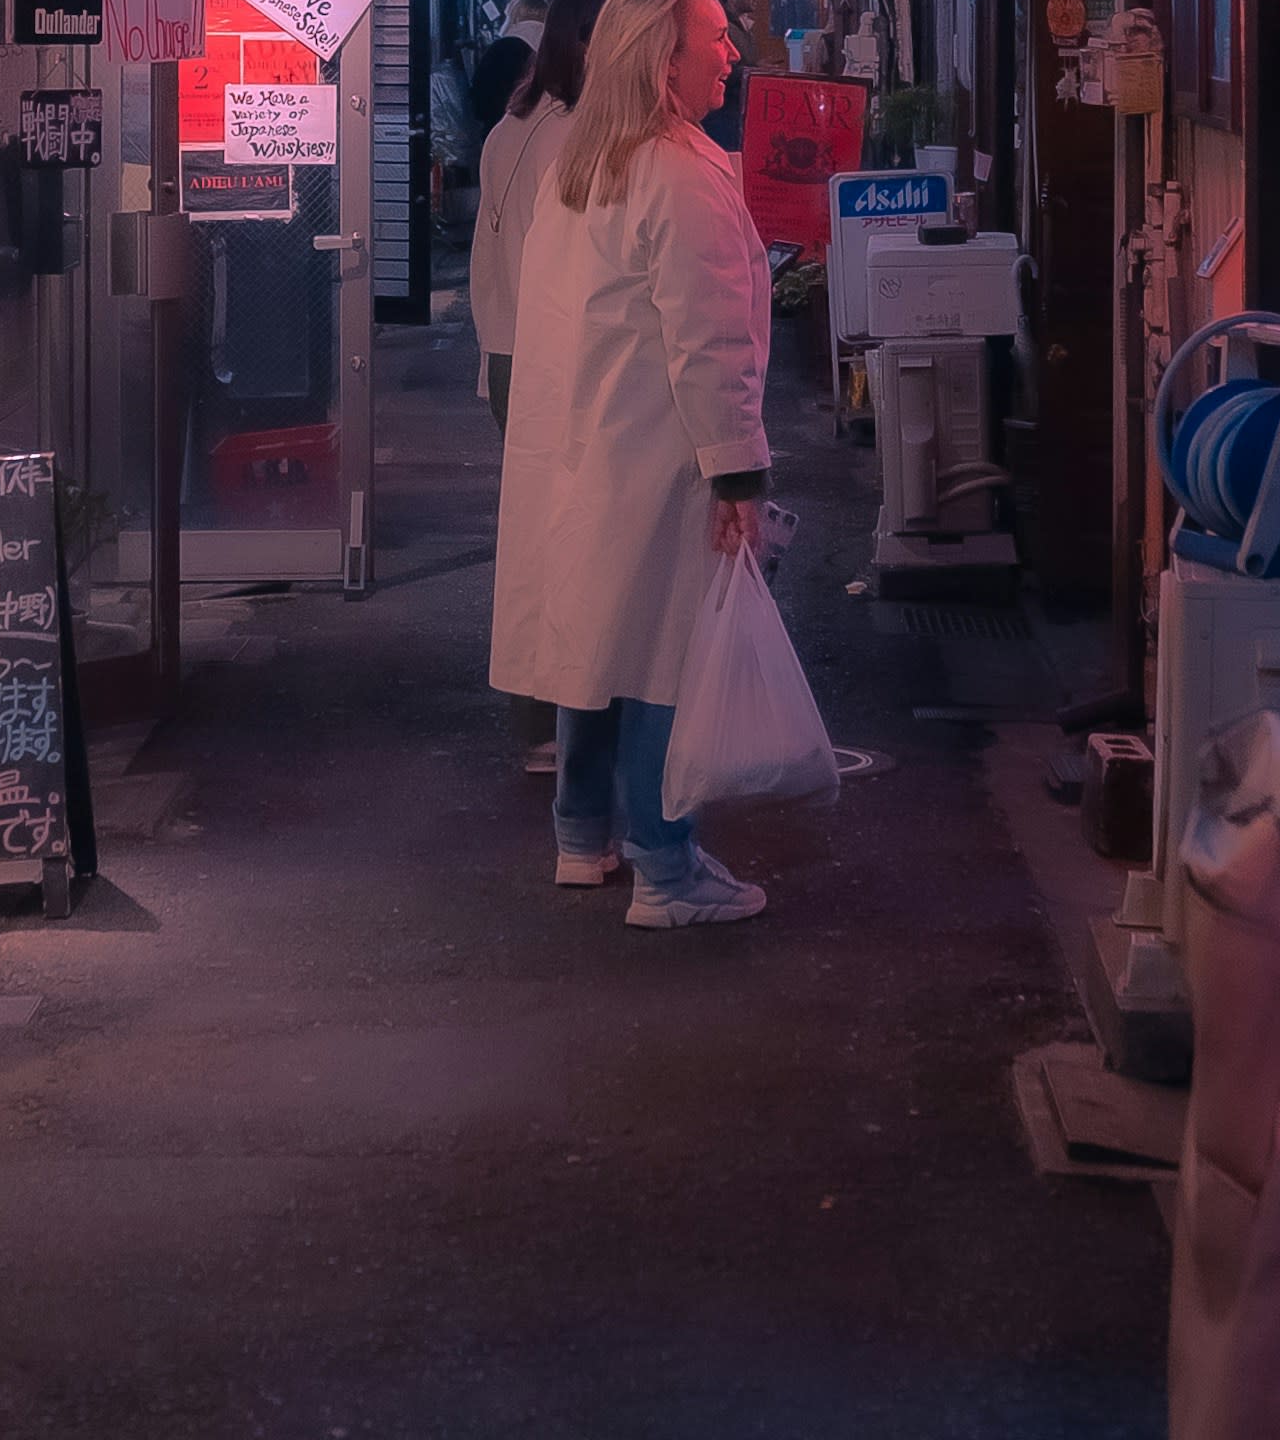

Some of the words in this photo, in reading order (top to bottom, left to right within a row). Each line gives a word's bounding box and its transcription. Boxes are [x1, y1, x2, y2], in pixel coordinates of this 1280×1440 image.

[34, 7, 101, 35] Outlander
[228, 92, 255, 106] We
[257, 90, 297, 107] Have
[299, 95, 310, 105] a
[762, 87, 854, 129] BAR
[288, 109, 309, 121] of
[231, 121, 298, 143] Japanese
[854, 179, 929, 213] Asahi
[862, 215, 927, 229] アサヒビール
